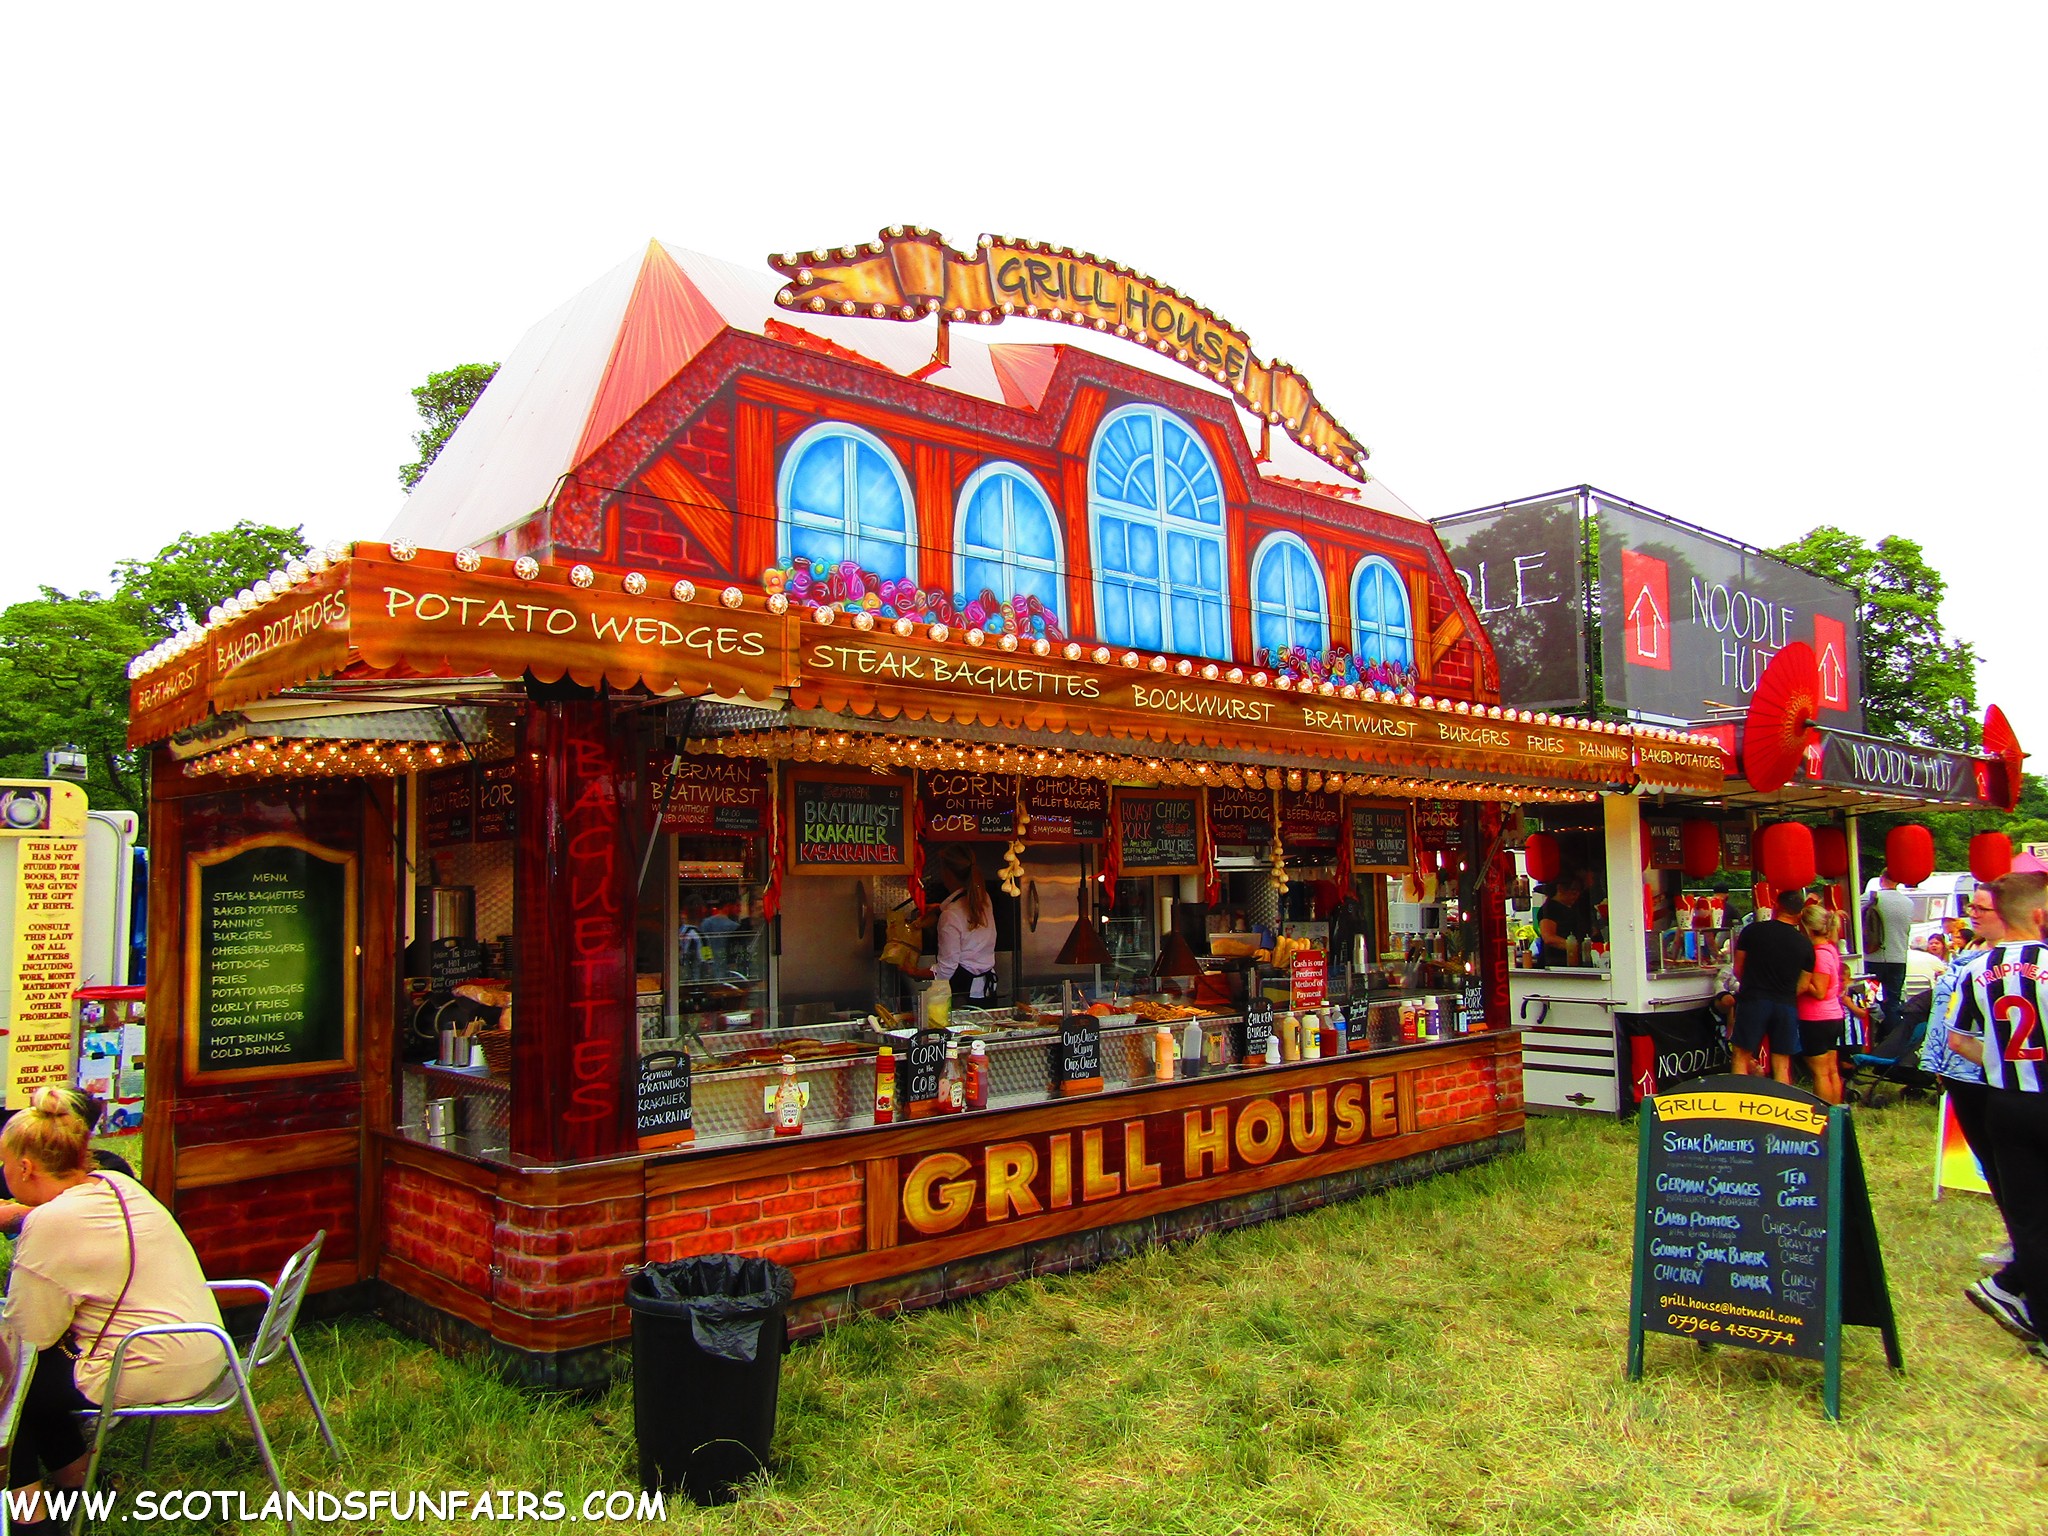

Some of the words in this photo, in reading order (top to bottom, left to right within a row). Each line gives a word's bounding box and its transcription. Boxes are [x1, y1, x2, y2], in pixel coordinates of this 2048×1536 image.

[997, 257, 1122, 313] GRILL
[1125, 280, 1247, 377] HOUSE
[1690, 576, 1794, 650] NOODLE
[217, 633, 261, 673] BAKED
[264, 589, 346, 651] POTATOES
[382, 586, 578, 635] POTATO
[590, 612, 765, 659] WEDGES
[808, 644, 925, 679] STEAK
[930, 657, 1101, 699] BAGUETTES
[1721, 638, 1775, 693] HUT
[138, 663, 200, 712] BRATWURST
[1131, 684, 1275, 723] BOCKWURST
[1302, 708, 1418, 739] BRATWURST
[1438, 722, 1510, 747] BURGERS
[1527, 734, 1564, 753] FRIES
[1579, 740, 1628, 761] PANINI'S
[1640, 747, 1674, 766] BAKED
[1674, 751, 1721, 769] POTATOES
[1852, 744, 1923, 788] NOODLE
[1924, 758, 1952, 791] HUT
[933, 774, 1009, 796] CORN
[1036, 780, 1098, 796] CHICKEN
[946, 798, 964, 809] ON
[968, 799, 994, 809] THE
[1218, 788, 1266, 802] JUMBO
[1032, 797, 1062, 807] FILLET
[1064, 799, 1101, 811] BURGER
[1122, 802, 1152, 820] ROAST
[1156, 802, 1191, 819] CHIPS
[678, 815, 704, 823] ONIONS
[804, 800, 899, 827] BRATWURST
[1213, 805, 1269, 822] HOTDOG
[1286, 808, 1338, 823] BEEFBURGER
[1422, 812, 1459, 826] PORK
[932, 814, 976, 831] COB
[1121, 822, 1152, 839] PORK
[804, 823, 888, 845] KRAKAUER
[800, 843, 899, 862] KASAKRAINER
[24, 873, 57, 881] BOOKS,
[252, 873, 288, 882] MENU
[213, 891, 247, 901] STEAK
[248, 890, 306, 901] BAGUETTES
[213, 906, 246, 916] BAKED
[248, 905, 298, 915] POTATOES
[213, 919, 264, 929] PANINI'S
[561, 737, 623, 1123] BAGUETTES
[213, 930, 273, 942] BURGERS
[212, 943, 305, 956] CHEESEBURGERS
[22, 963, 73, 971] INCLUDING
[211, 959, 270, 971] HOTDOGS
[1294, 960, 1307, 968] Cash
[19, 973, 45, 981] WORK,
[211, 975, 247, 985] FRIES
[1296, 969, 1322, 978] Preferred
[1974, 962, 2048, 988] TRIPPIER
[22, 982, 71, 990] MATRIMONY
[211, 986, 256, 998] POTATO
[258, 984, 305, 995] WEDGES
[1295, 979, 1316, 988] Method
[1296, 991, 1321, 1000] Payment
[1466, 988, 1481, 997] ROAST
[211, 1001, 253, 1013] CURLY
[255, 999, 290, 1010] FRIES
[1465, 995, 1483, 1008] PORK
[20, 1012, 71, 1021] PROBLEMS.
[211, 1016, 242, 1027] CORN
[243, 1014, 259, 1024] ON
[261, 1013, 282, 1023] THE
[283, 1011, 304, 1021] COB
[1248, 1011, 1273, 1026] CHICKEN
[1247, 1026, 1272, 1039] BURGER
[1992, 994, 2044, 1061] 2
[17, 1034, 31, 1042] ALL
[34, 1033, 71, 1041] READINGS
[211, 1035, 237, 1046] HOT
[239, 1032, 285, 1043] DRINKS
[16, 1042, 71, 1052] CONFIDENTIAL
[210, 1049, 243, 1059] COLD
[245, 1044, 292, 1055] DRINKS
[911, 1044, 945, 1065] CORN
[21, 1066, 39, 1074] SHE
[42, 1064, 64, 1072] ALSO
[1658, 1046, 1720, 1078] NOODLE
[17, 1076, 47, 1084] READS
[638, 1076, 689, 1096] BRATWURST
[642, 1070, 673, 1087] German
[912, 1075, 937, 1093] COB
[638, 1092, 686, 1112] KRAKAUER
[637, 1107, 693, 1129] KASAKRAINER
[1658, 1099, 1726, 1115] GRILL
[1739, 1101, 1826, 1126] HOUSE
[1662, 1131, 1701, 1153] STEAK
[1703, 1133, 1755, 1153] BAGUETTES
[902, 1119, 1162, 1235] GRILL
[1183, 1076, 1399, 1180] HOUSE
[1777, 1167, 1807, 1185] TEA
[1656, 1173, 1704, 1193] GERMAN
[1706, 1176, 1761, 1197] SAUSAGES
[1777, 1190, 1818, 1208] COFFEE
[1653, 1206, 1688, 1227] BAKED
[1690, 1210, 1740, 1230] POTATOES
[1762, 1214, 1792, 1235] CHIPS
[1650, 1237, 1694, 1258] GOURMET
[1696, 1241, 1728, 1263] STEAK
[1728, 1246, 1768, 1268] BURGER
[1780, 1251, 1815, 1266] CHEESE
[1653, 1263, 1703, 1284] CHICKEN
[1730, 1272, 1772, 1295] BURGER
[1781, 1269, 1817, 1288] CURLY
[1782, 1289, 1816, 1309] FRIES
[1659, 1293, 1803, 1326] grill.house@hotmail.com
[1667, 1314, 1721, 1333] 07966
[1725, 1323, 1795, 1345] 455774
